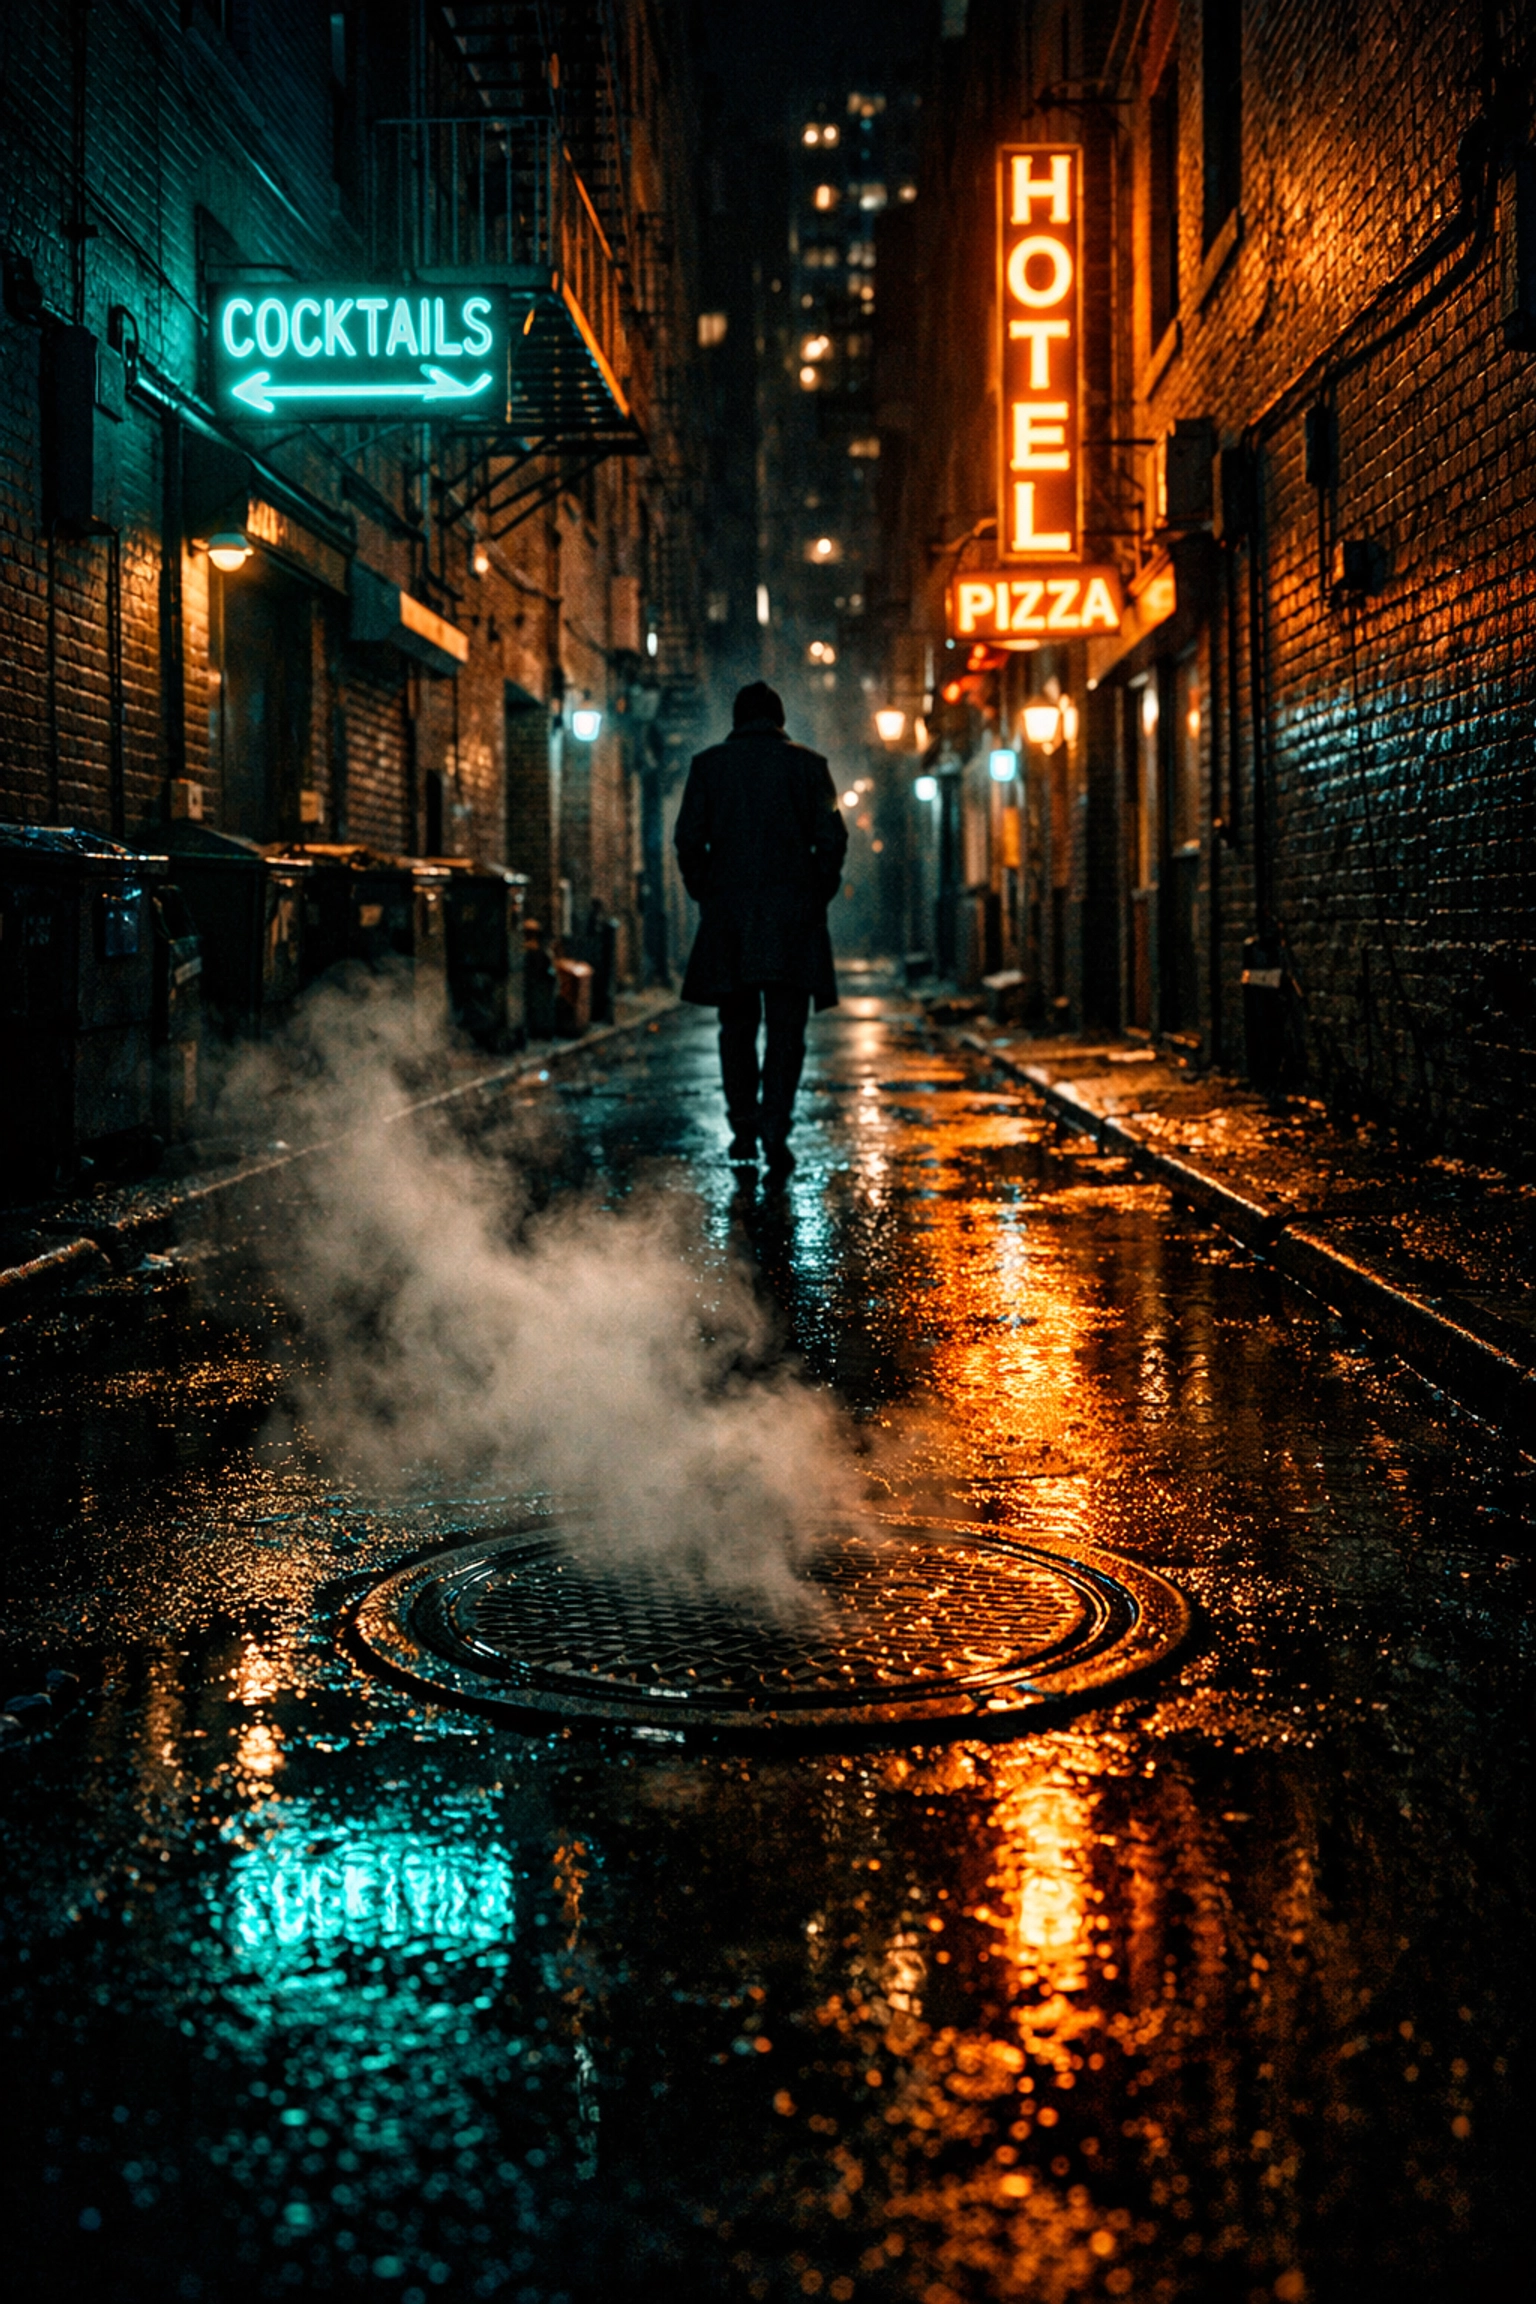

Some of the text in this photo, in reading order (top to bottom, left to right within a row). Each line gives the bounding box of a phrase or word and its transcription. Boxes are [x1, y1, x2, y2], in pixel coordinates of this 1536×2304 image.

[221, 296, 494, 358] COCKTAILS
[1006, 154, 1074, 553] HOTEL
[957, 578, 1120, 633] PIZZA
